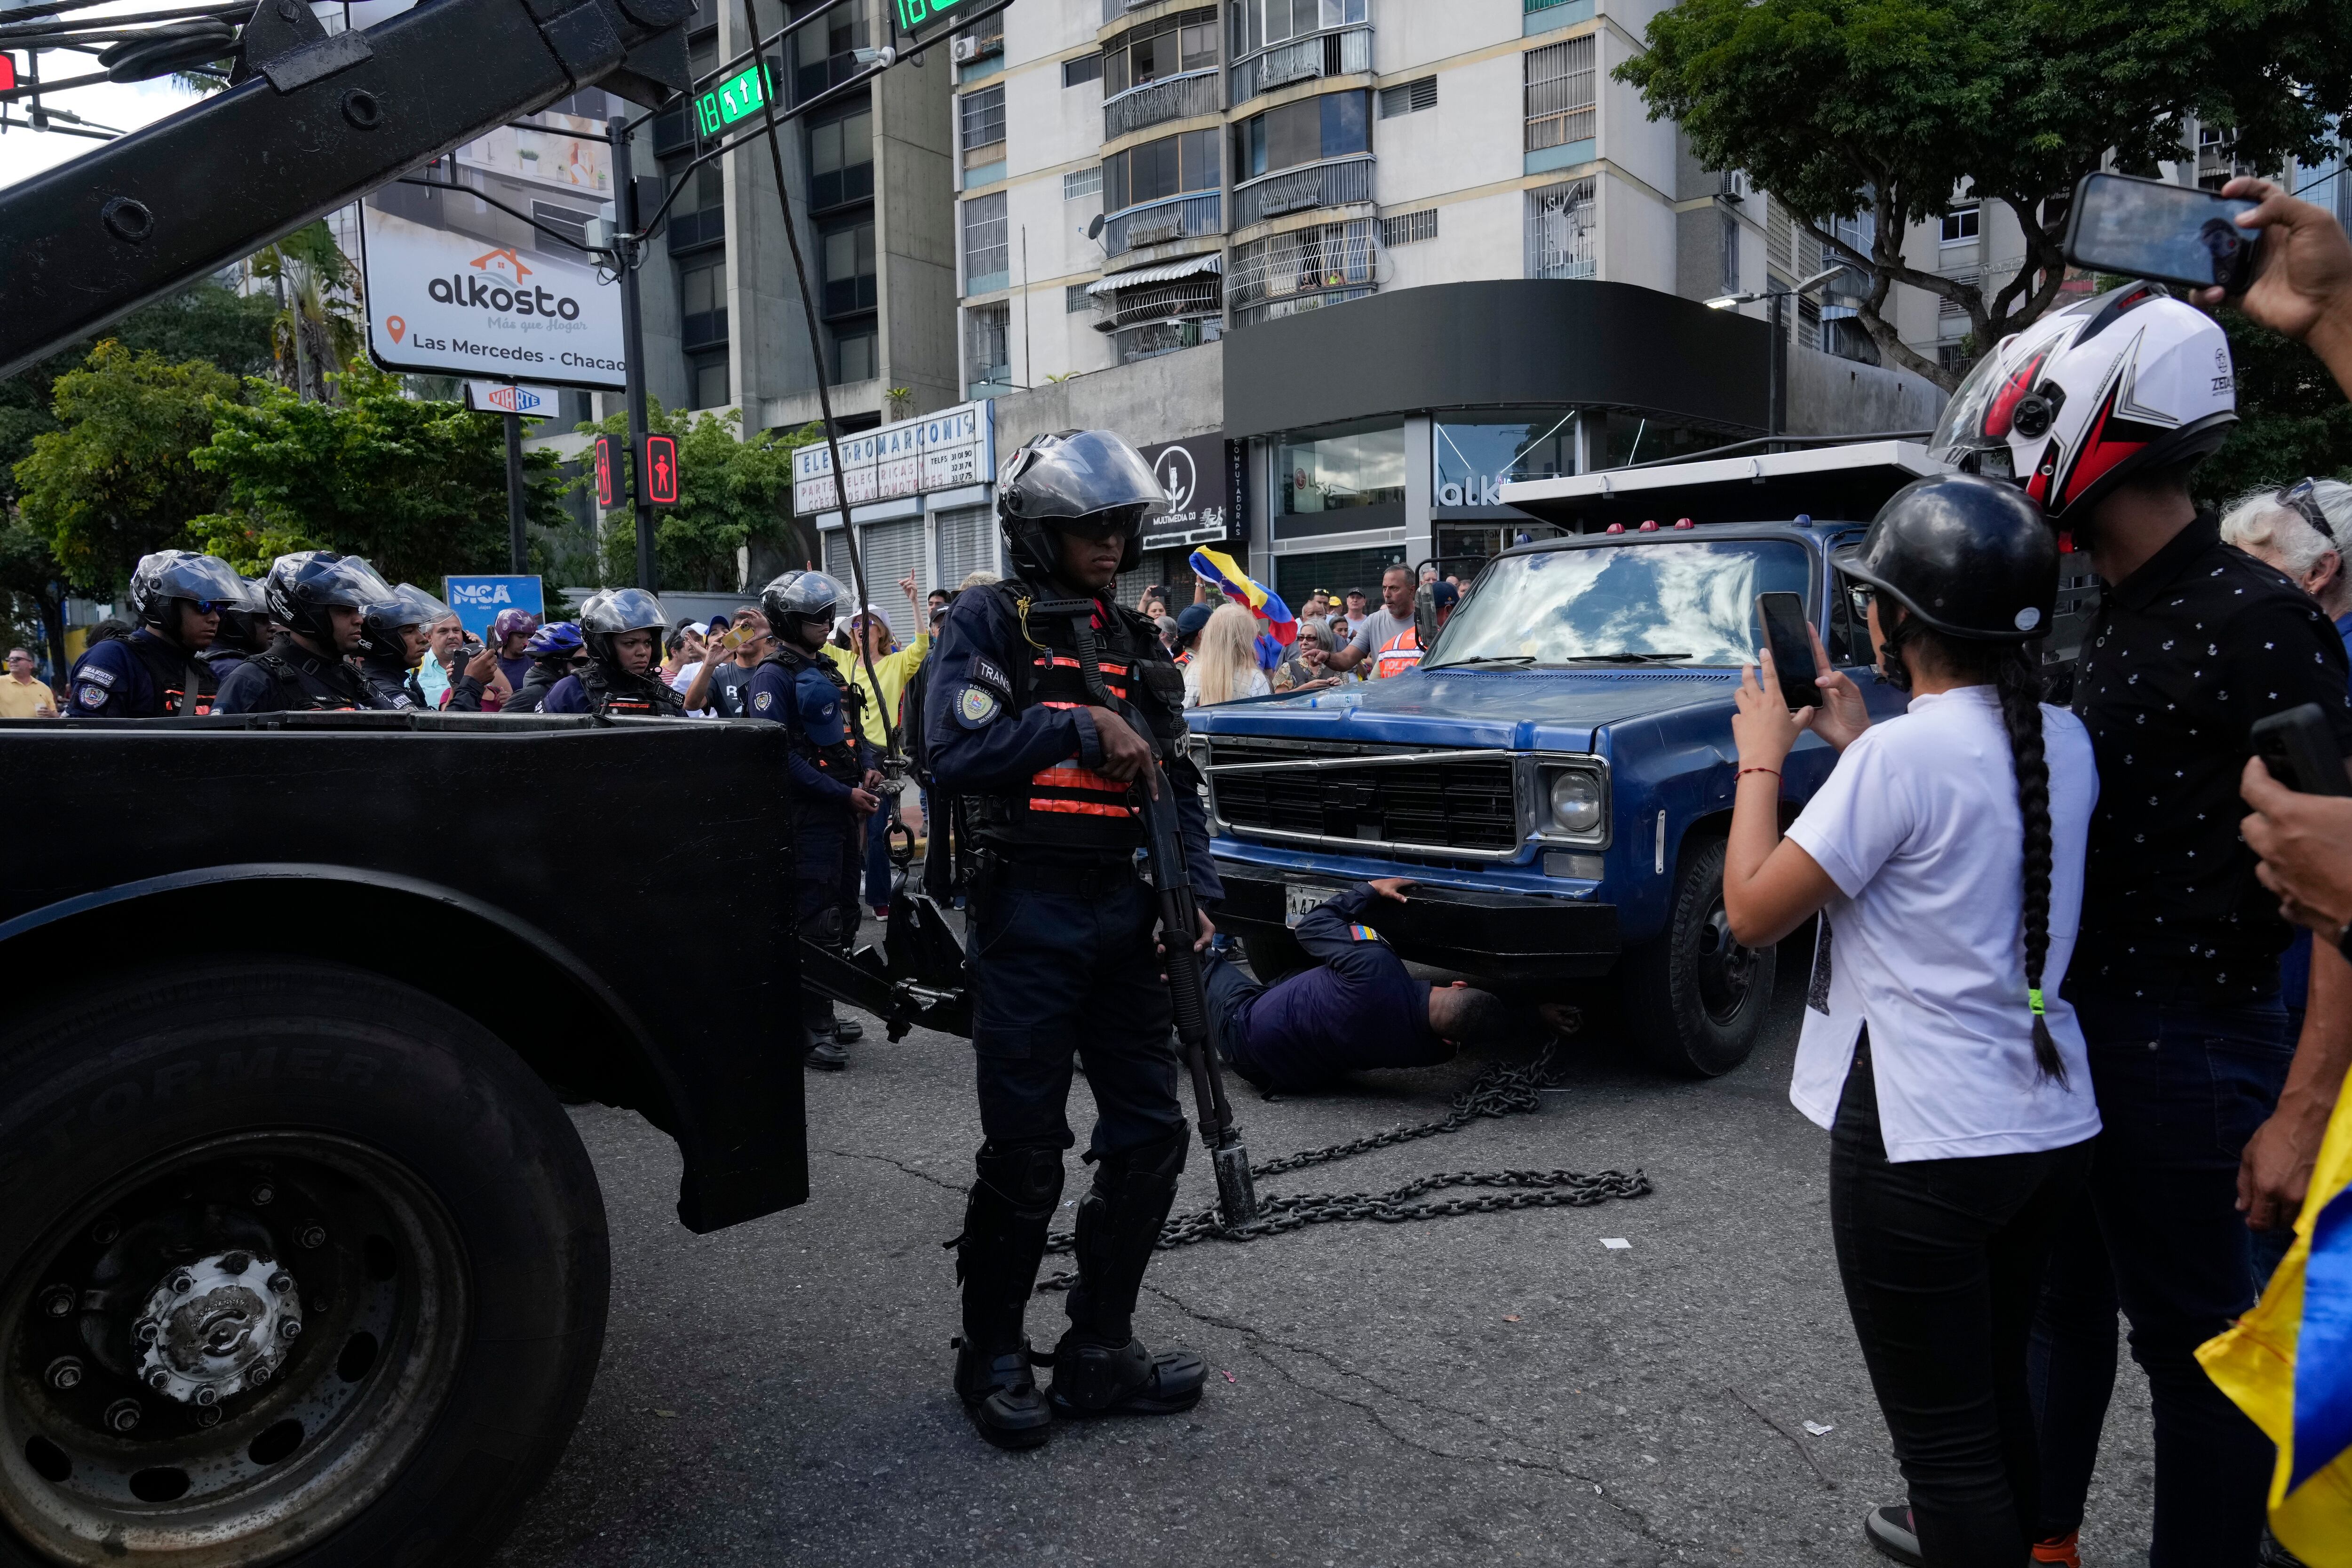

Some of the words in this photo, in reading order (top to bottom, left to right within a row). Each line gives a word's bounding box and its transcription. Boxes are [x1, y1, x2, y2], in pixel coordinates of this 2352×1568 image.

[696, 93, 720, 136] 18
[429, 274, 580, 320] alkosto
[488, 316, 516, 329] Más
[520, 321, 543, 333] que
[546, 317, 588, 333] Hogar
[413, 334, 446, 351] Las
[453, 339, 544, 362] Mercedes
[561, 352, 626, 372] Chacao
[492, 388, 538, 410] VIARTE
[804, 417, 960, 473] ELETROMARCONI
[931, 455, 947, 465] TELFS
[802, 480, 835, 497] PARTE
[1233, 439, 1243, 536] COMPUTADORAS
[1439, 475, 1500, 506] alk
[1153, 512, 1187, 525] MULTIMEDIA
[1189, 512, 1196, 521] DJ
[453, 584, 512, 604] MCA
[272, 595, 294, 621] EDGE
[83, 667, 113, 680] TRANSITO
[956, 689, 965, 715] NACIONAL
[969, 684, 994, 699] POLICIA
[978, 705, 998, 724] BOLIVARIANA
[1291, 896, 1323, 918] A47
